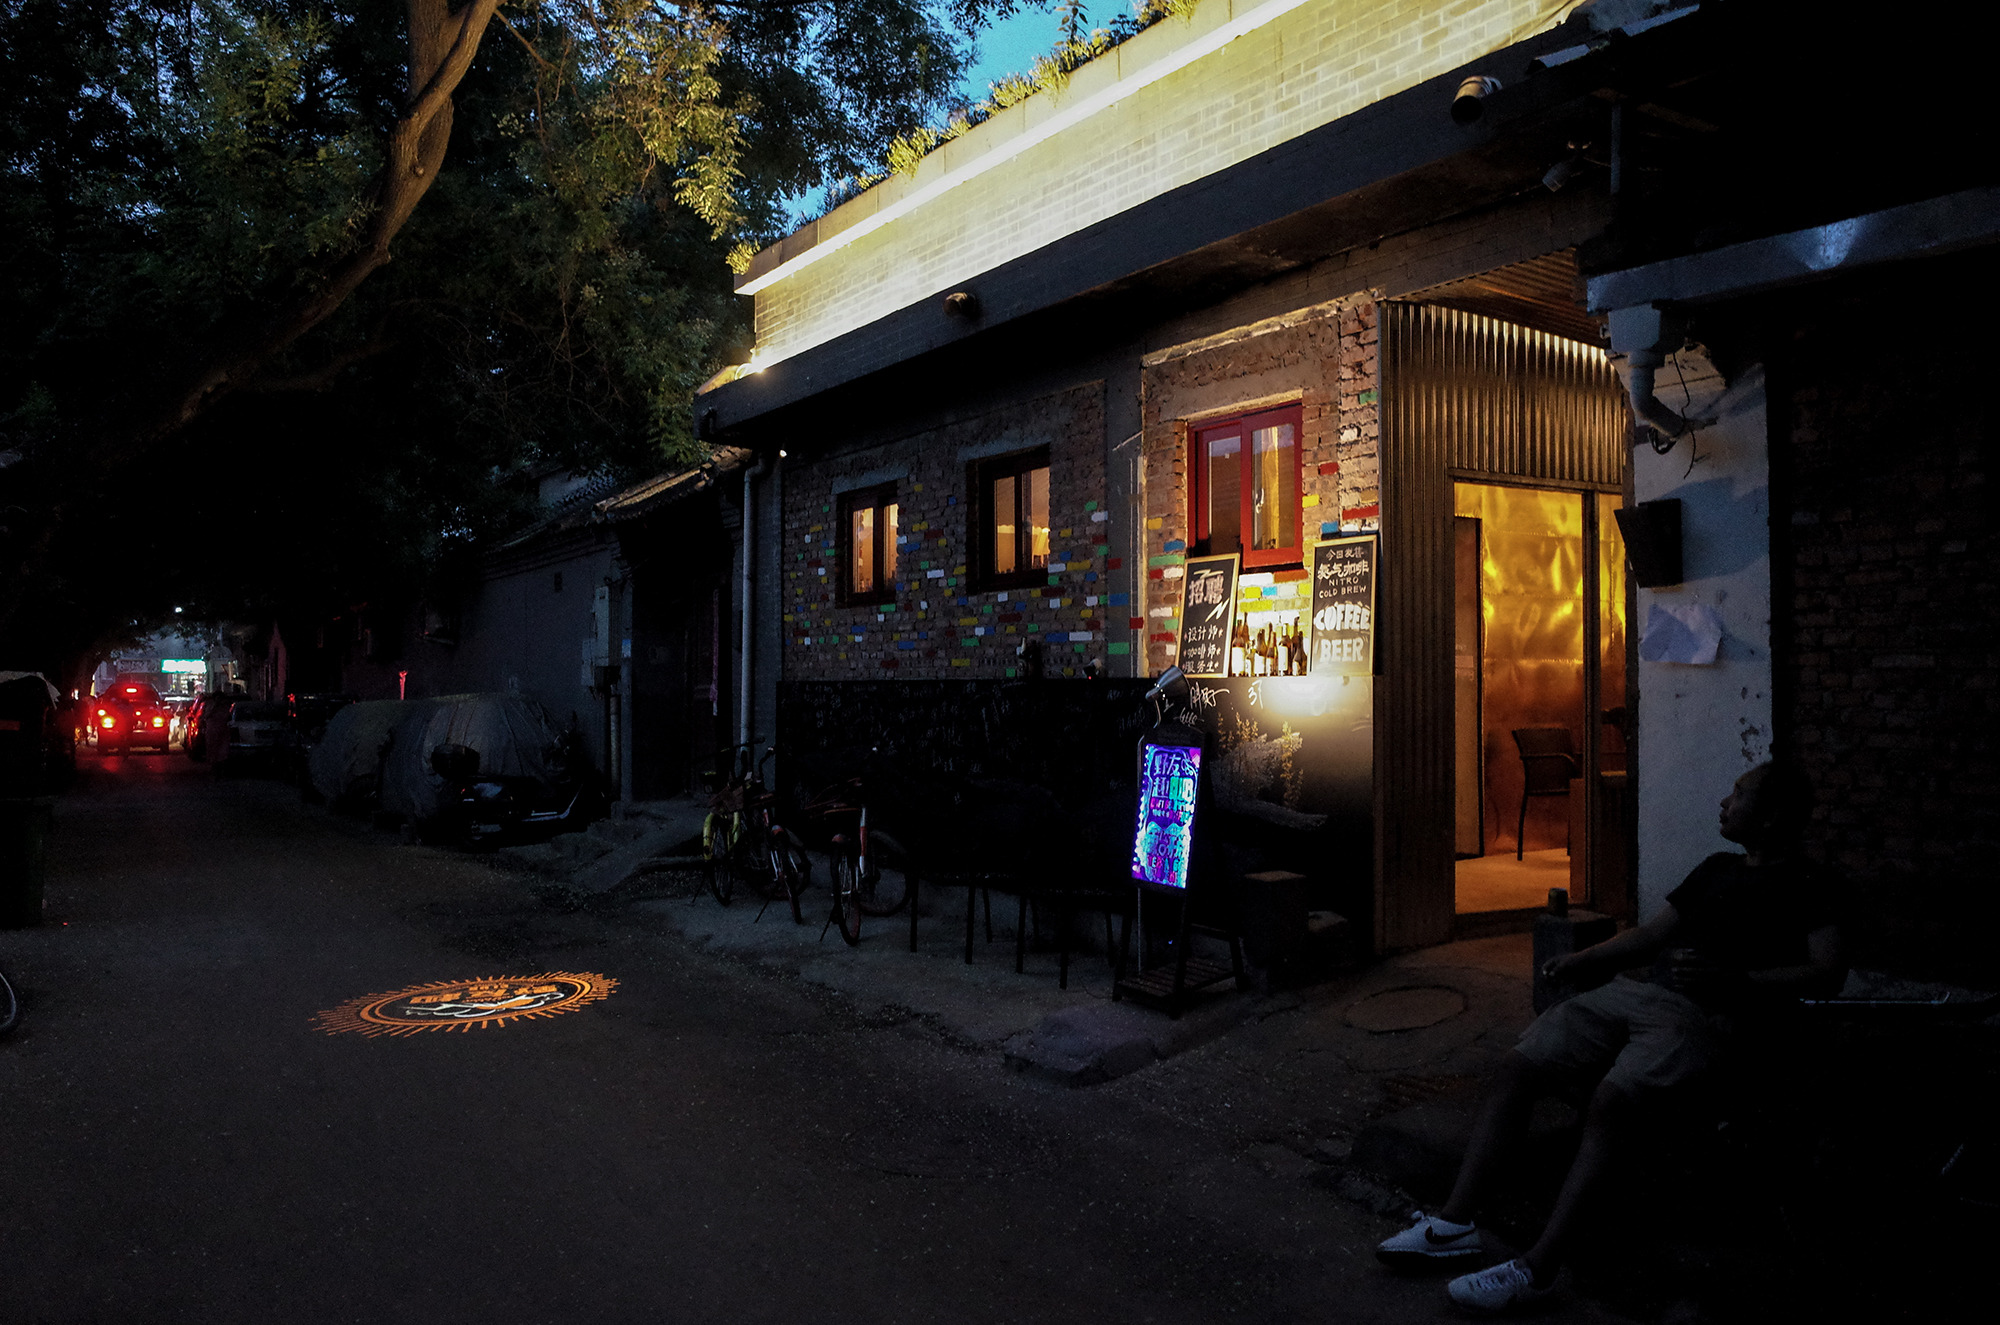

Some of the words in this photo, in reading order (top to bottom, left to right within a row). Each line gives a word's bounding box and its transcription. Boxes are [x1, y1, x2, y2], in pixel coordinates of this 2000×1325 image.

[1328, 576, 1359, 587] NITRO
[1188, 574, 1225, 608] 招聘
[1318, 587, 1338, 598] COLD
[1341, 584, 1367, 596] BREW
[1314, 603, 1371, 631] COFFEE
[1188, 624, 1218, 643] 设计师
[1187, 643, 1217, 659] 咖啡师
[1319, 637, 1364, 663] BEER
[1184, 661, 1215, 674] 服务生
